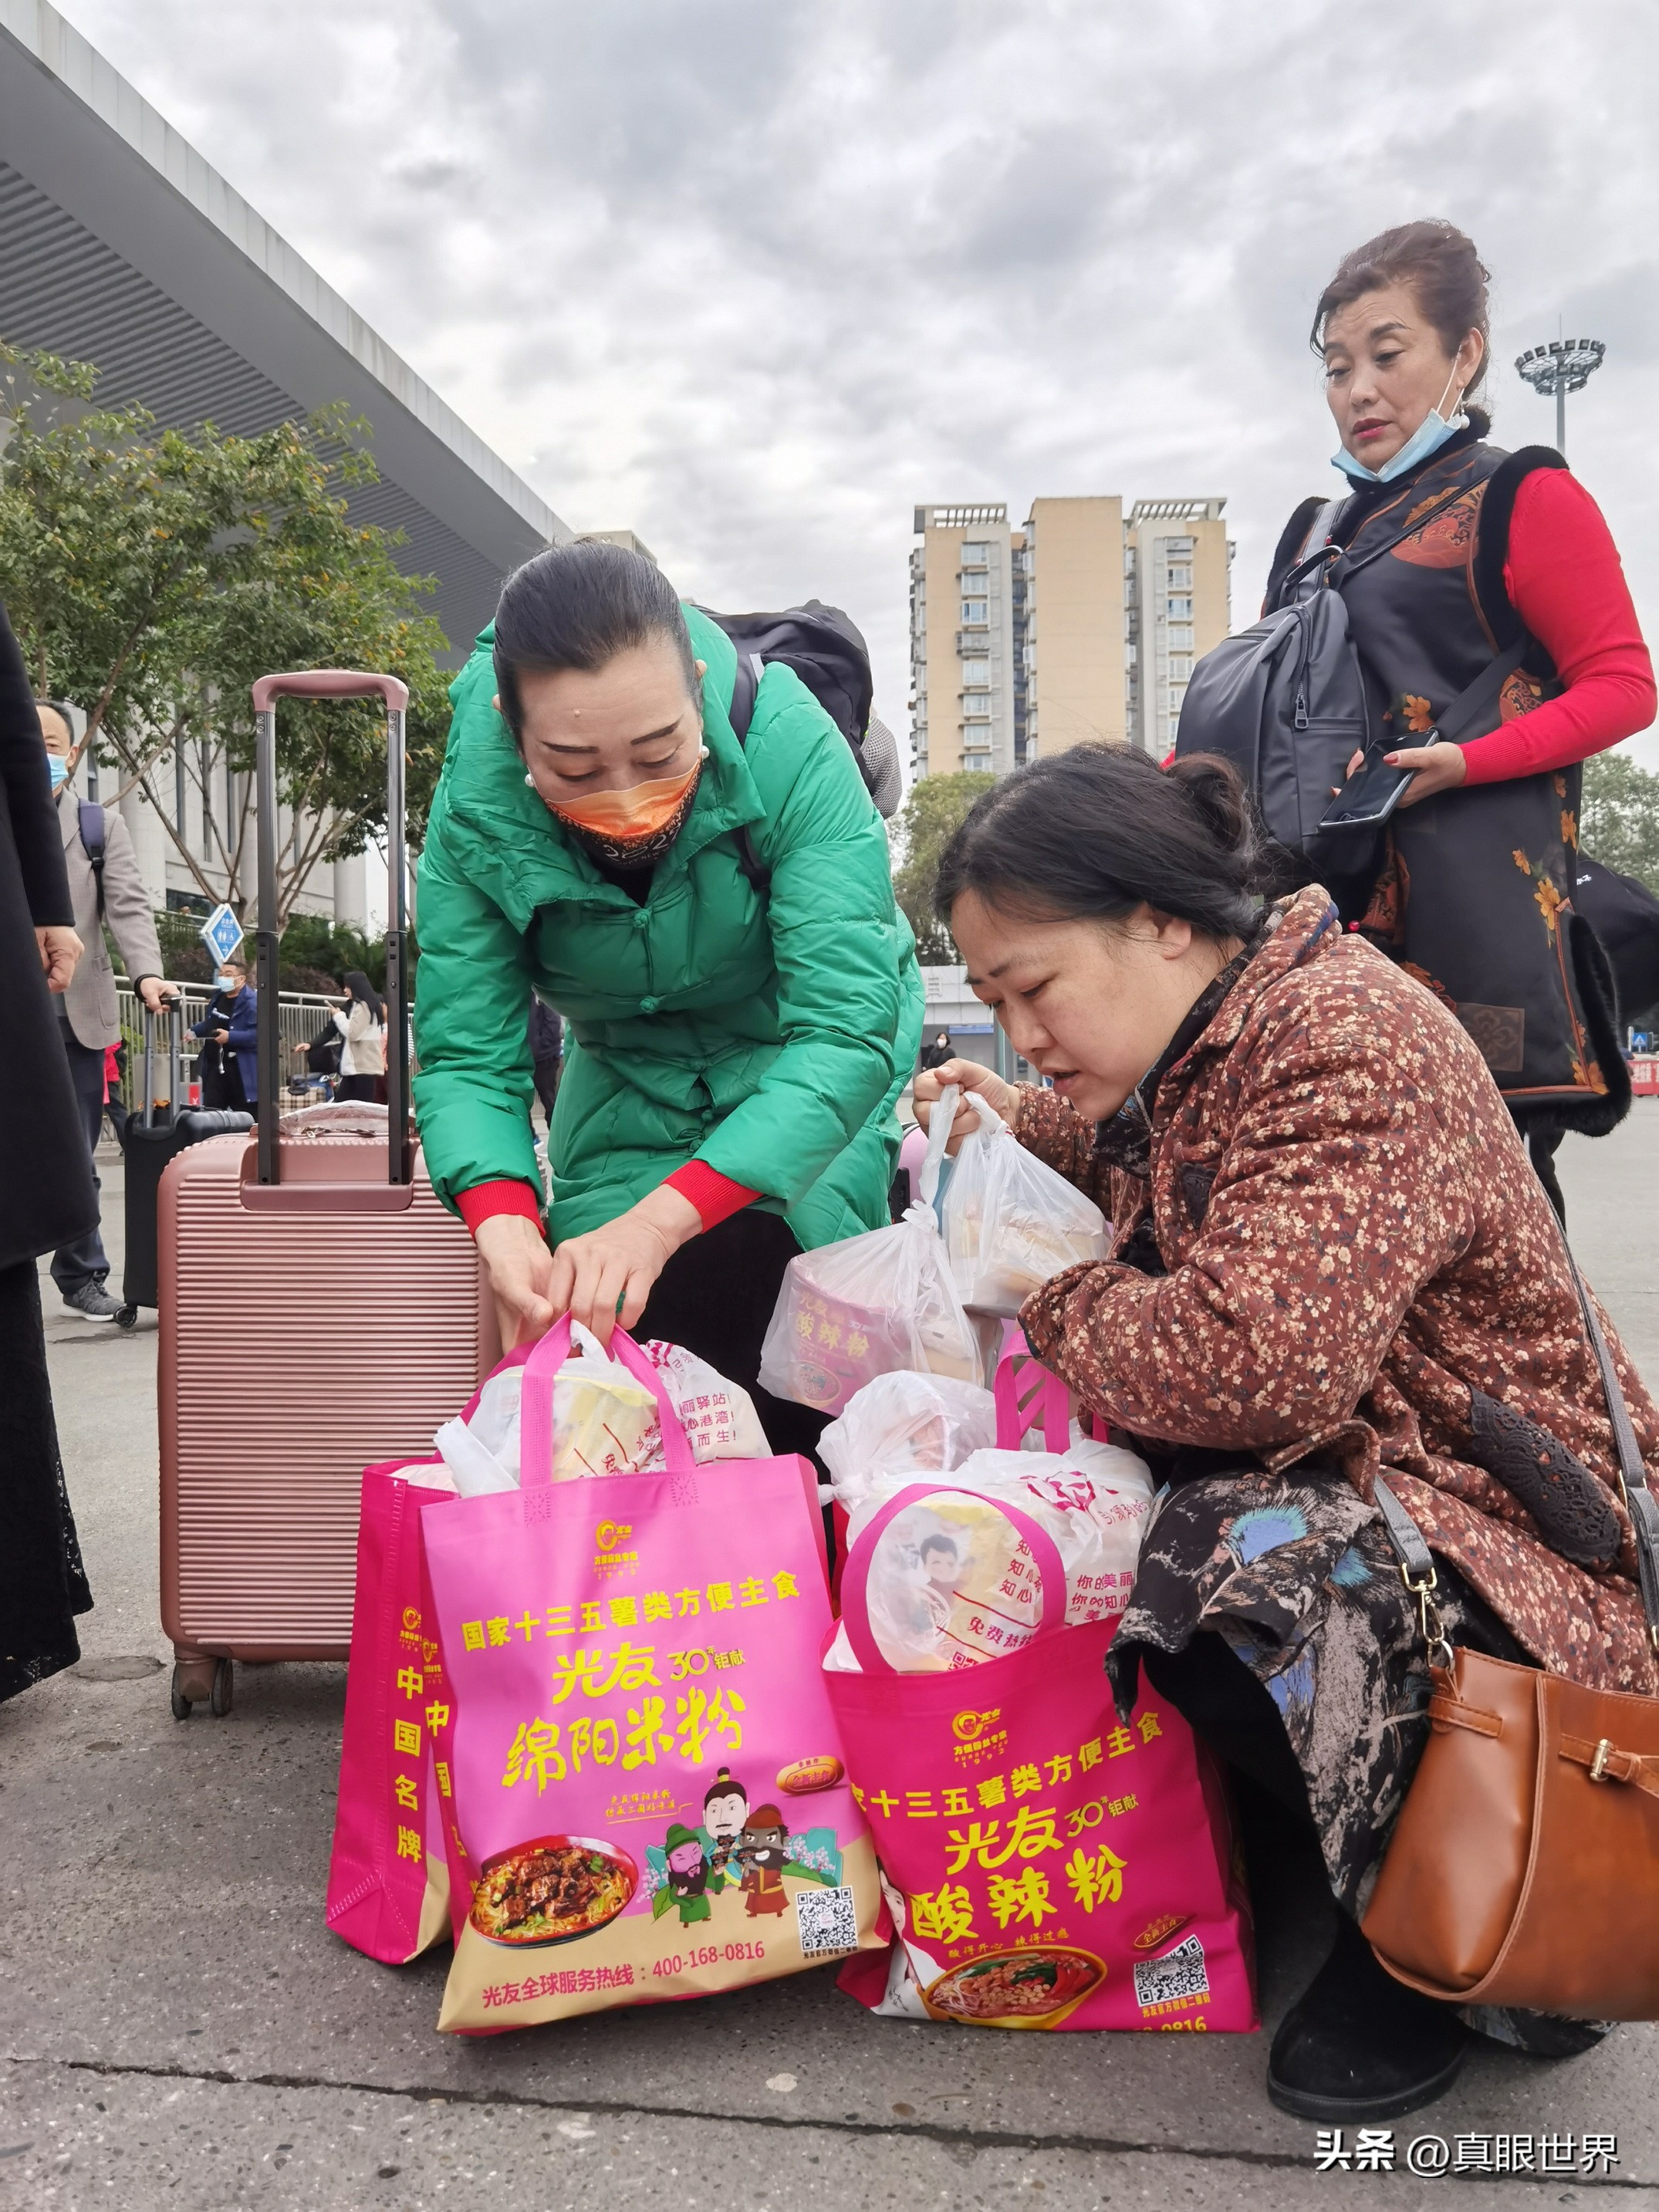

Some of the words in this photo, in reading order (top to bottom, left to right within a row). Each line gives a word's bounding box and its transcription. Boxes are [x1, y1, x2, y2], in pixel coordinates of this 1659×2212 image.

[796, 1311, 870, 1359] 酸辣粉
[461, 1569, 800, 1653] 国家十三五薯类方便主食
[552, 1641, 664, 1705] 光友
[394, 1666, 422, 1863] 中国名牌
[502, 1685, 747, 1798] 绵阳米粉
[945, 1805, 1065, 1876] 光友
[911, 1844, 1128, 1944] 酸辣粉
